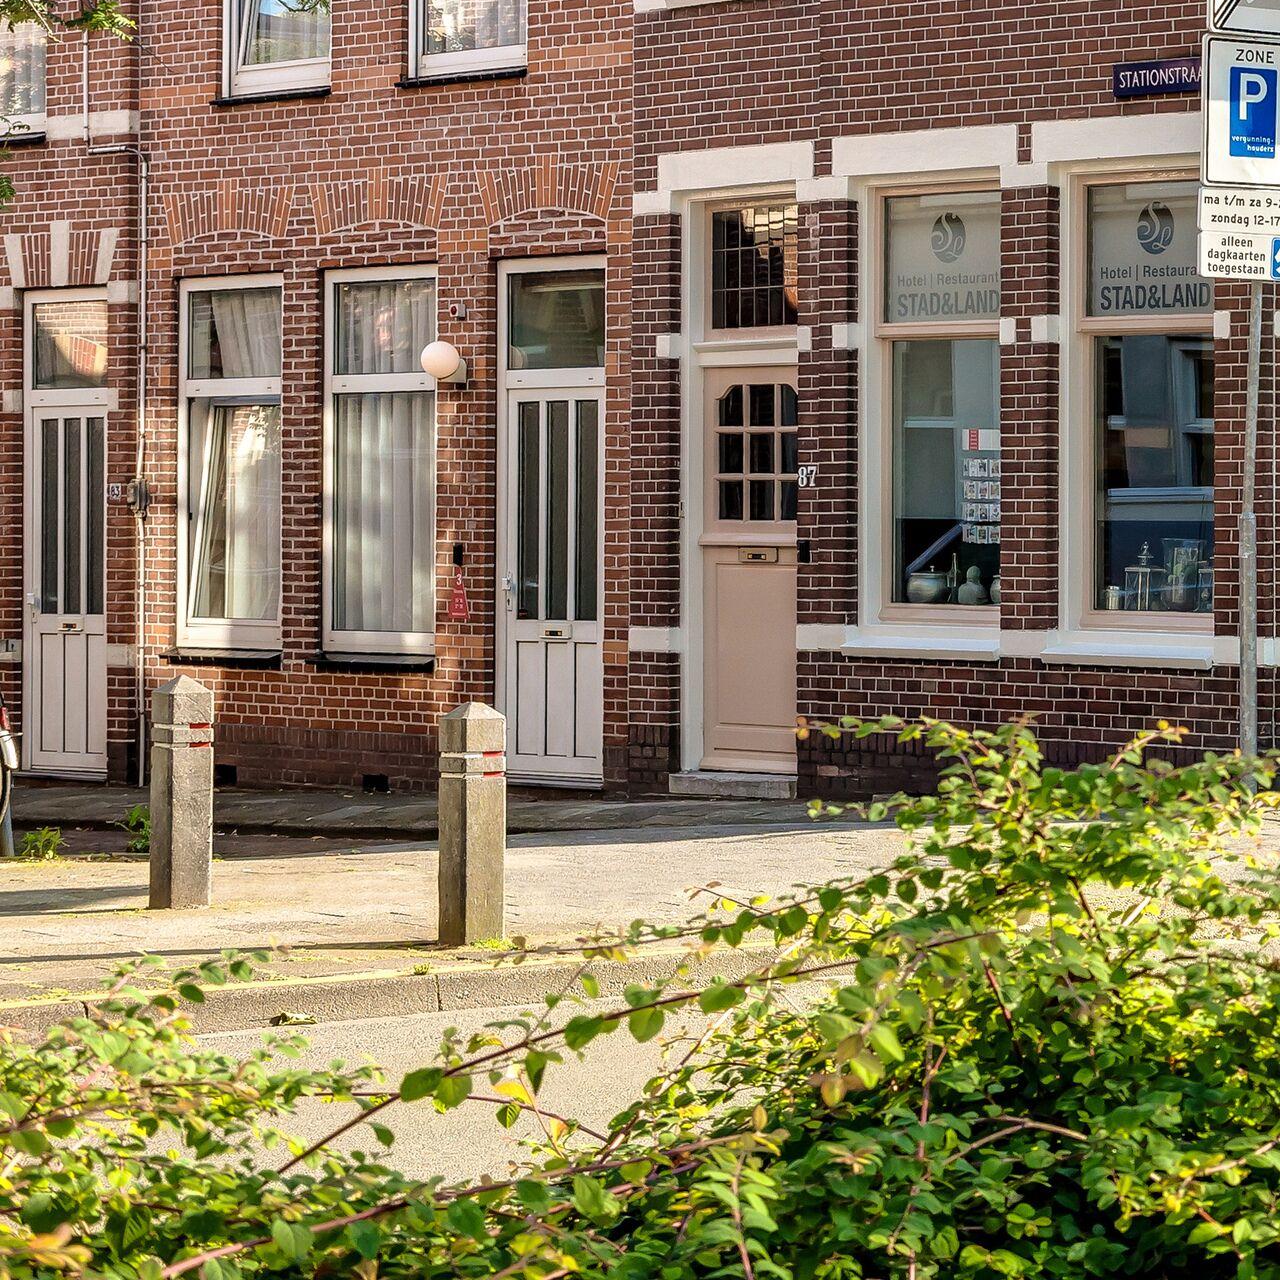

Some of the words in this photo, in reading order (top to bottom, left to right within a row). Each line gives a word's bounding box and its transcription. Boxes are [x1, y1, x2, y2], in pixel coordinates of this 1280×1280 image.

[1236, 49, 1275, 64] ZONE
[1247, 144, 1274, 153] houders
[1204, 196, 1220, 205] ma
[1224, 195, 1245, 207] t/m
[1249, 198, 1261, 207] za
[1211, 214, 1250, 227] zondag
[1221, 236, 1253, 247] alleen
[1207, 249, 1266, 262] dagkaarten
[1100, 266, 1132, 279] Hotel
[1208, 263, 1265, 275] toegestaan
[898, 274, 927, 287] Hotel
[937, 272, 999, 285] Restaurant
[897, 290, 1000, 317] STAD&LAND
[1100, 283, 1211, 311] STAD&LAND
[798, 466, 817, 487] 87
[456, 573, 462, 586] 3
